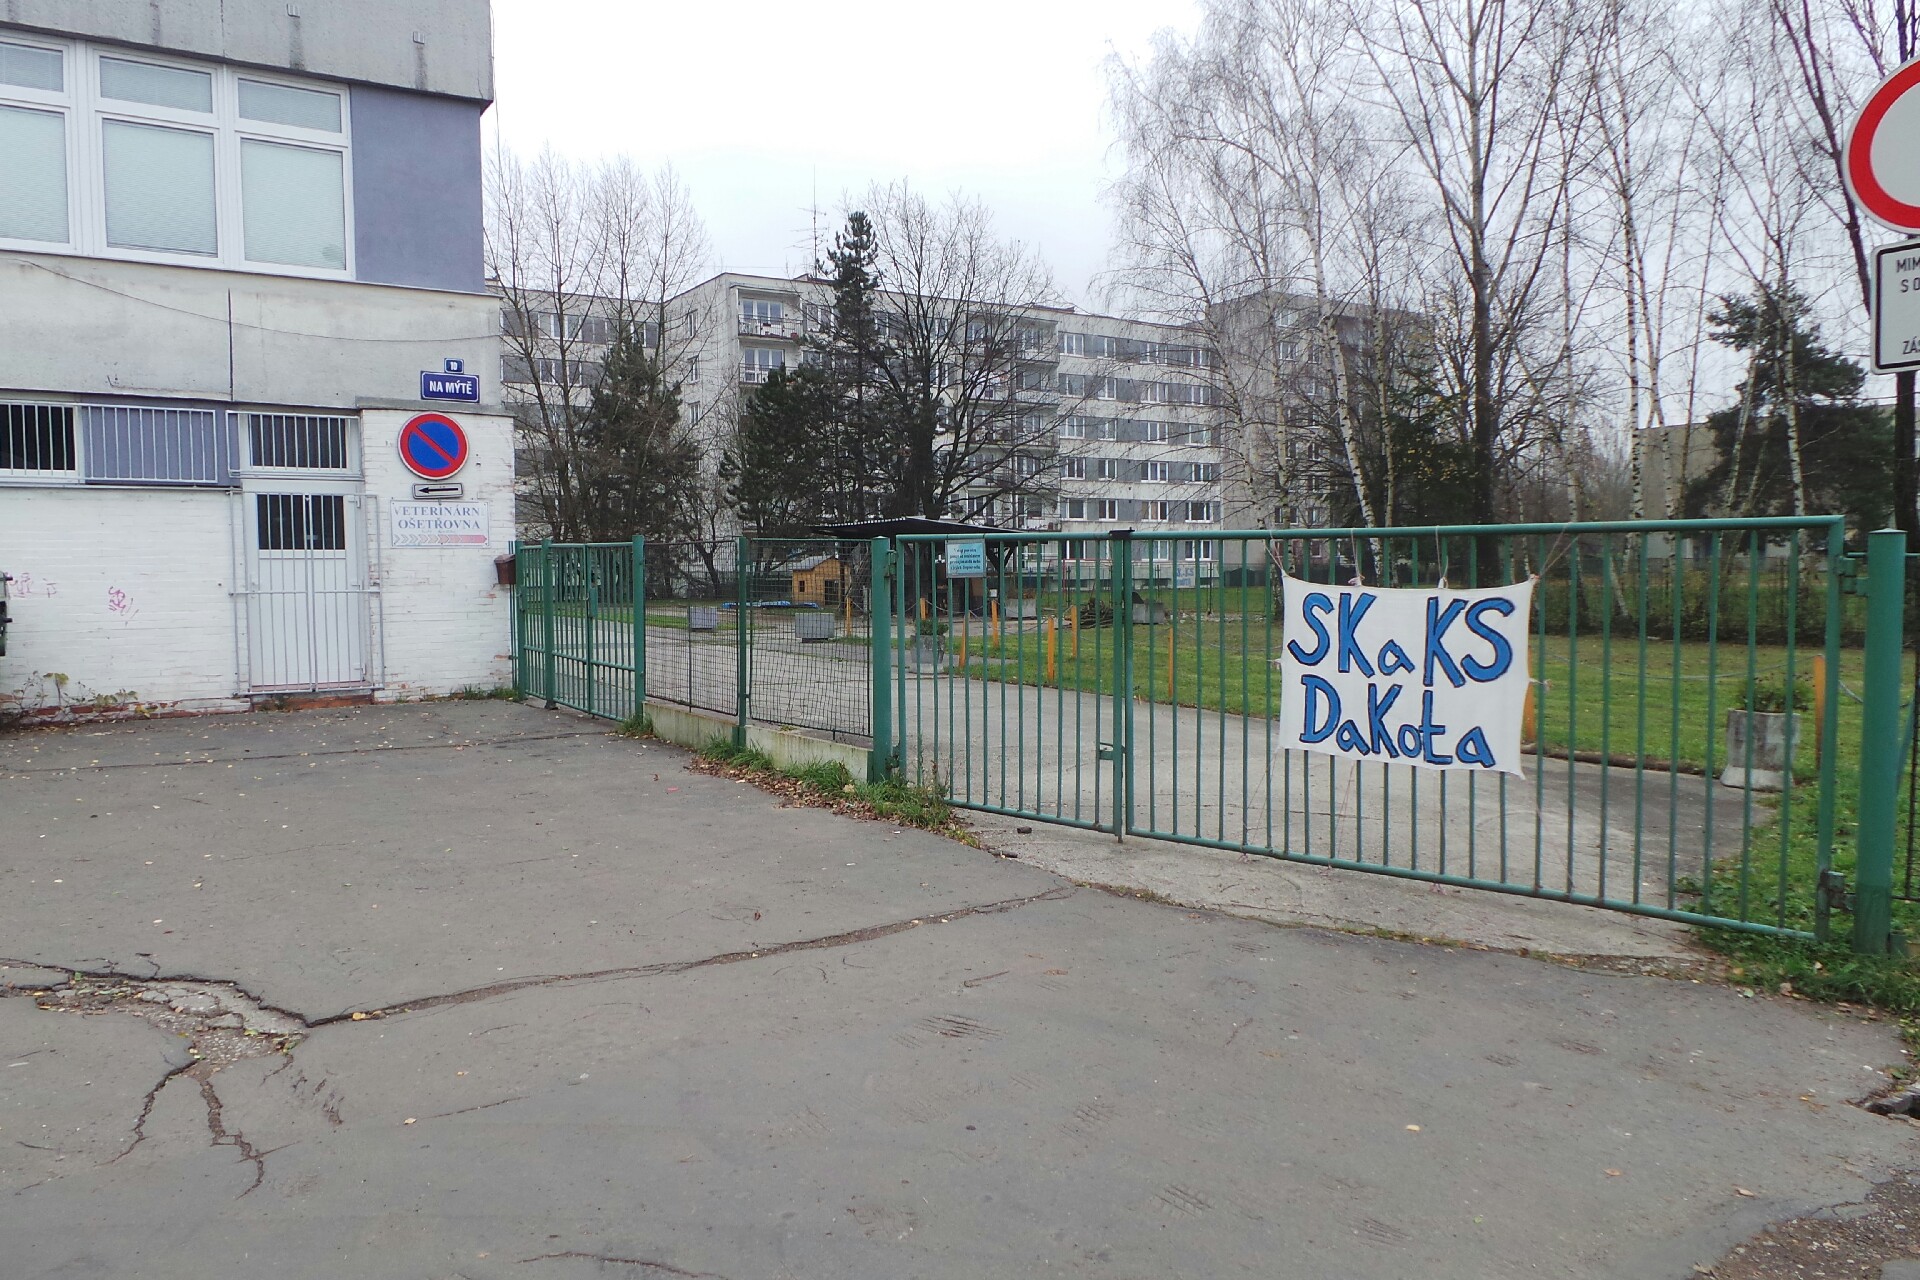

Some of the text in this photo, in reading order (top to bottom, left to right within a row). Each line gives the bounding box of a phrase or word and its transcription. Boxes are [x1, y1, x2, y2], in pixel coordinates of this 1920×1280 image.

[429, 379, 473, 395] NA MÝTĚ
[394, 504, 484, 517] VETERINÁRN
[398, 517, 481, 530] OŠETŘOVNA
[1299, 674, 1496, 768] DaKota
